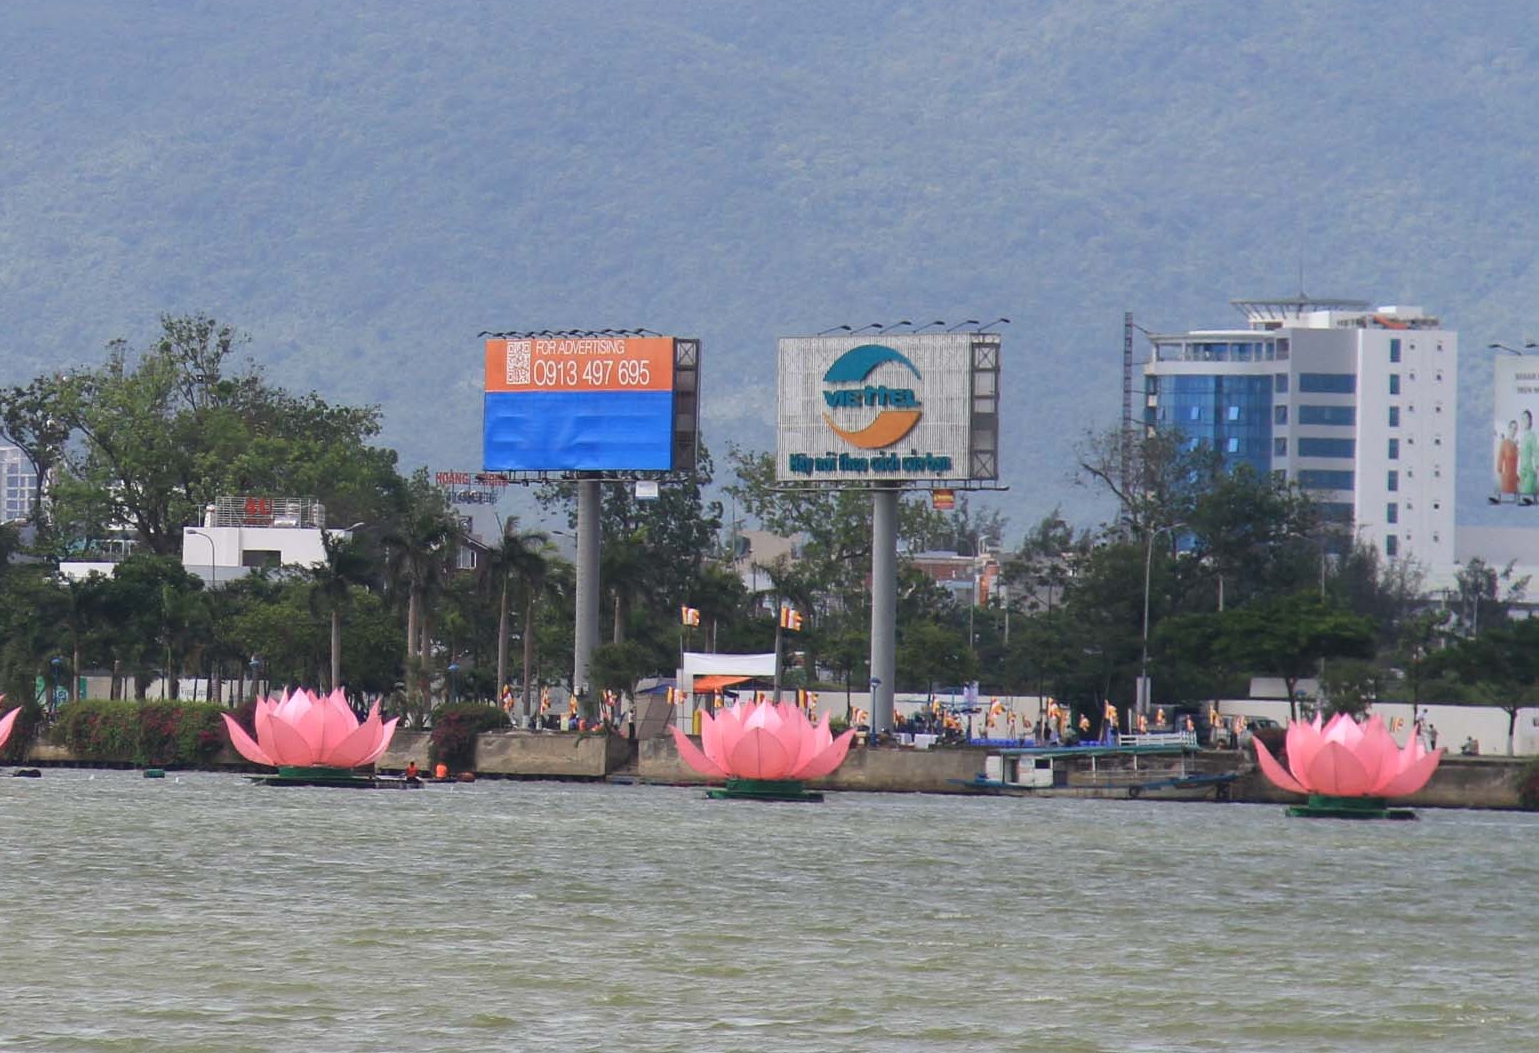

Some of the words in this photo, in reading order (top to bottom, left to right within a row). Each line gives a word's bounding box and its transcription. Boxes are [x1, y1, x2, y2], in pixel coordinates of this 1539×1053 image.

[536, 340, 556, 356] FOR
[557, 339, 625, 356] ADVERTISING
[533, 359, 578, 386] 0913
[582, 360, 613, 386] 497
[618, 359, 650, 385] 695
